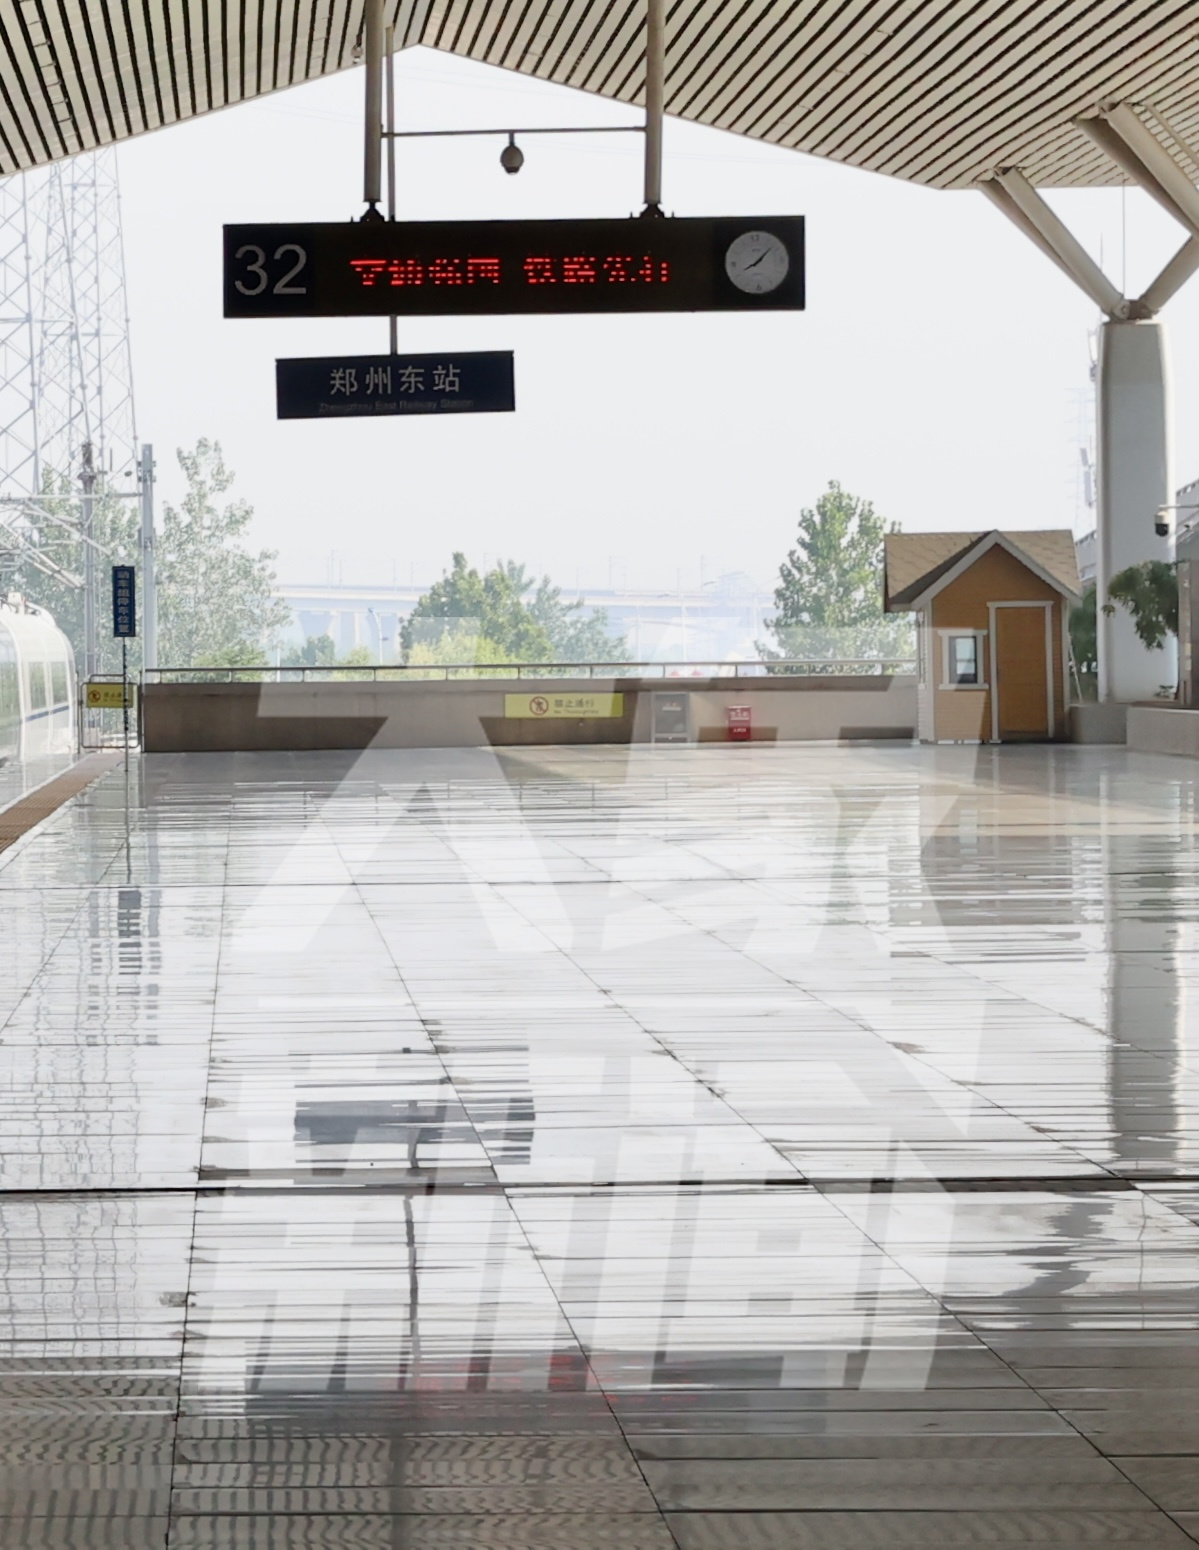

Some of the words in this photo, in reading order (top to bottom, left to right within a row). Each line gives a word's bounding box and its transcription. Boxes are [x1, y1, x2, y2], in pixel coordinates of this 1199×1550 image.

[234, 243, 307, 296] 32
[329, 363, 461, 396] 郑州东站
